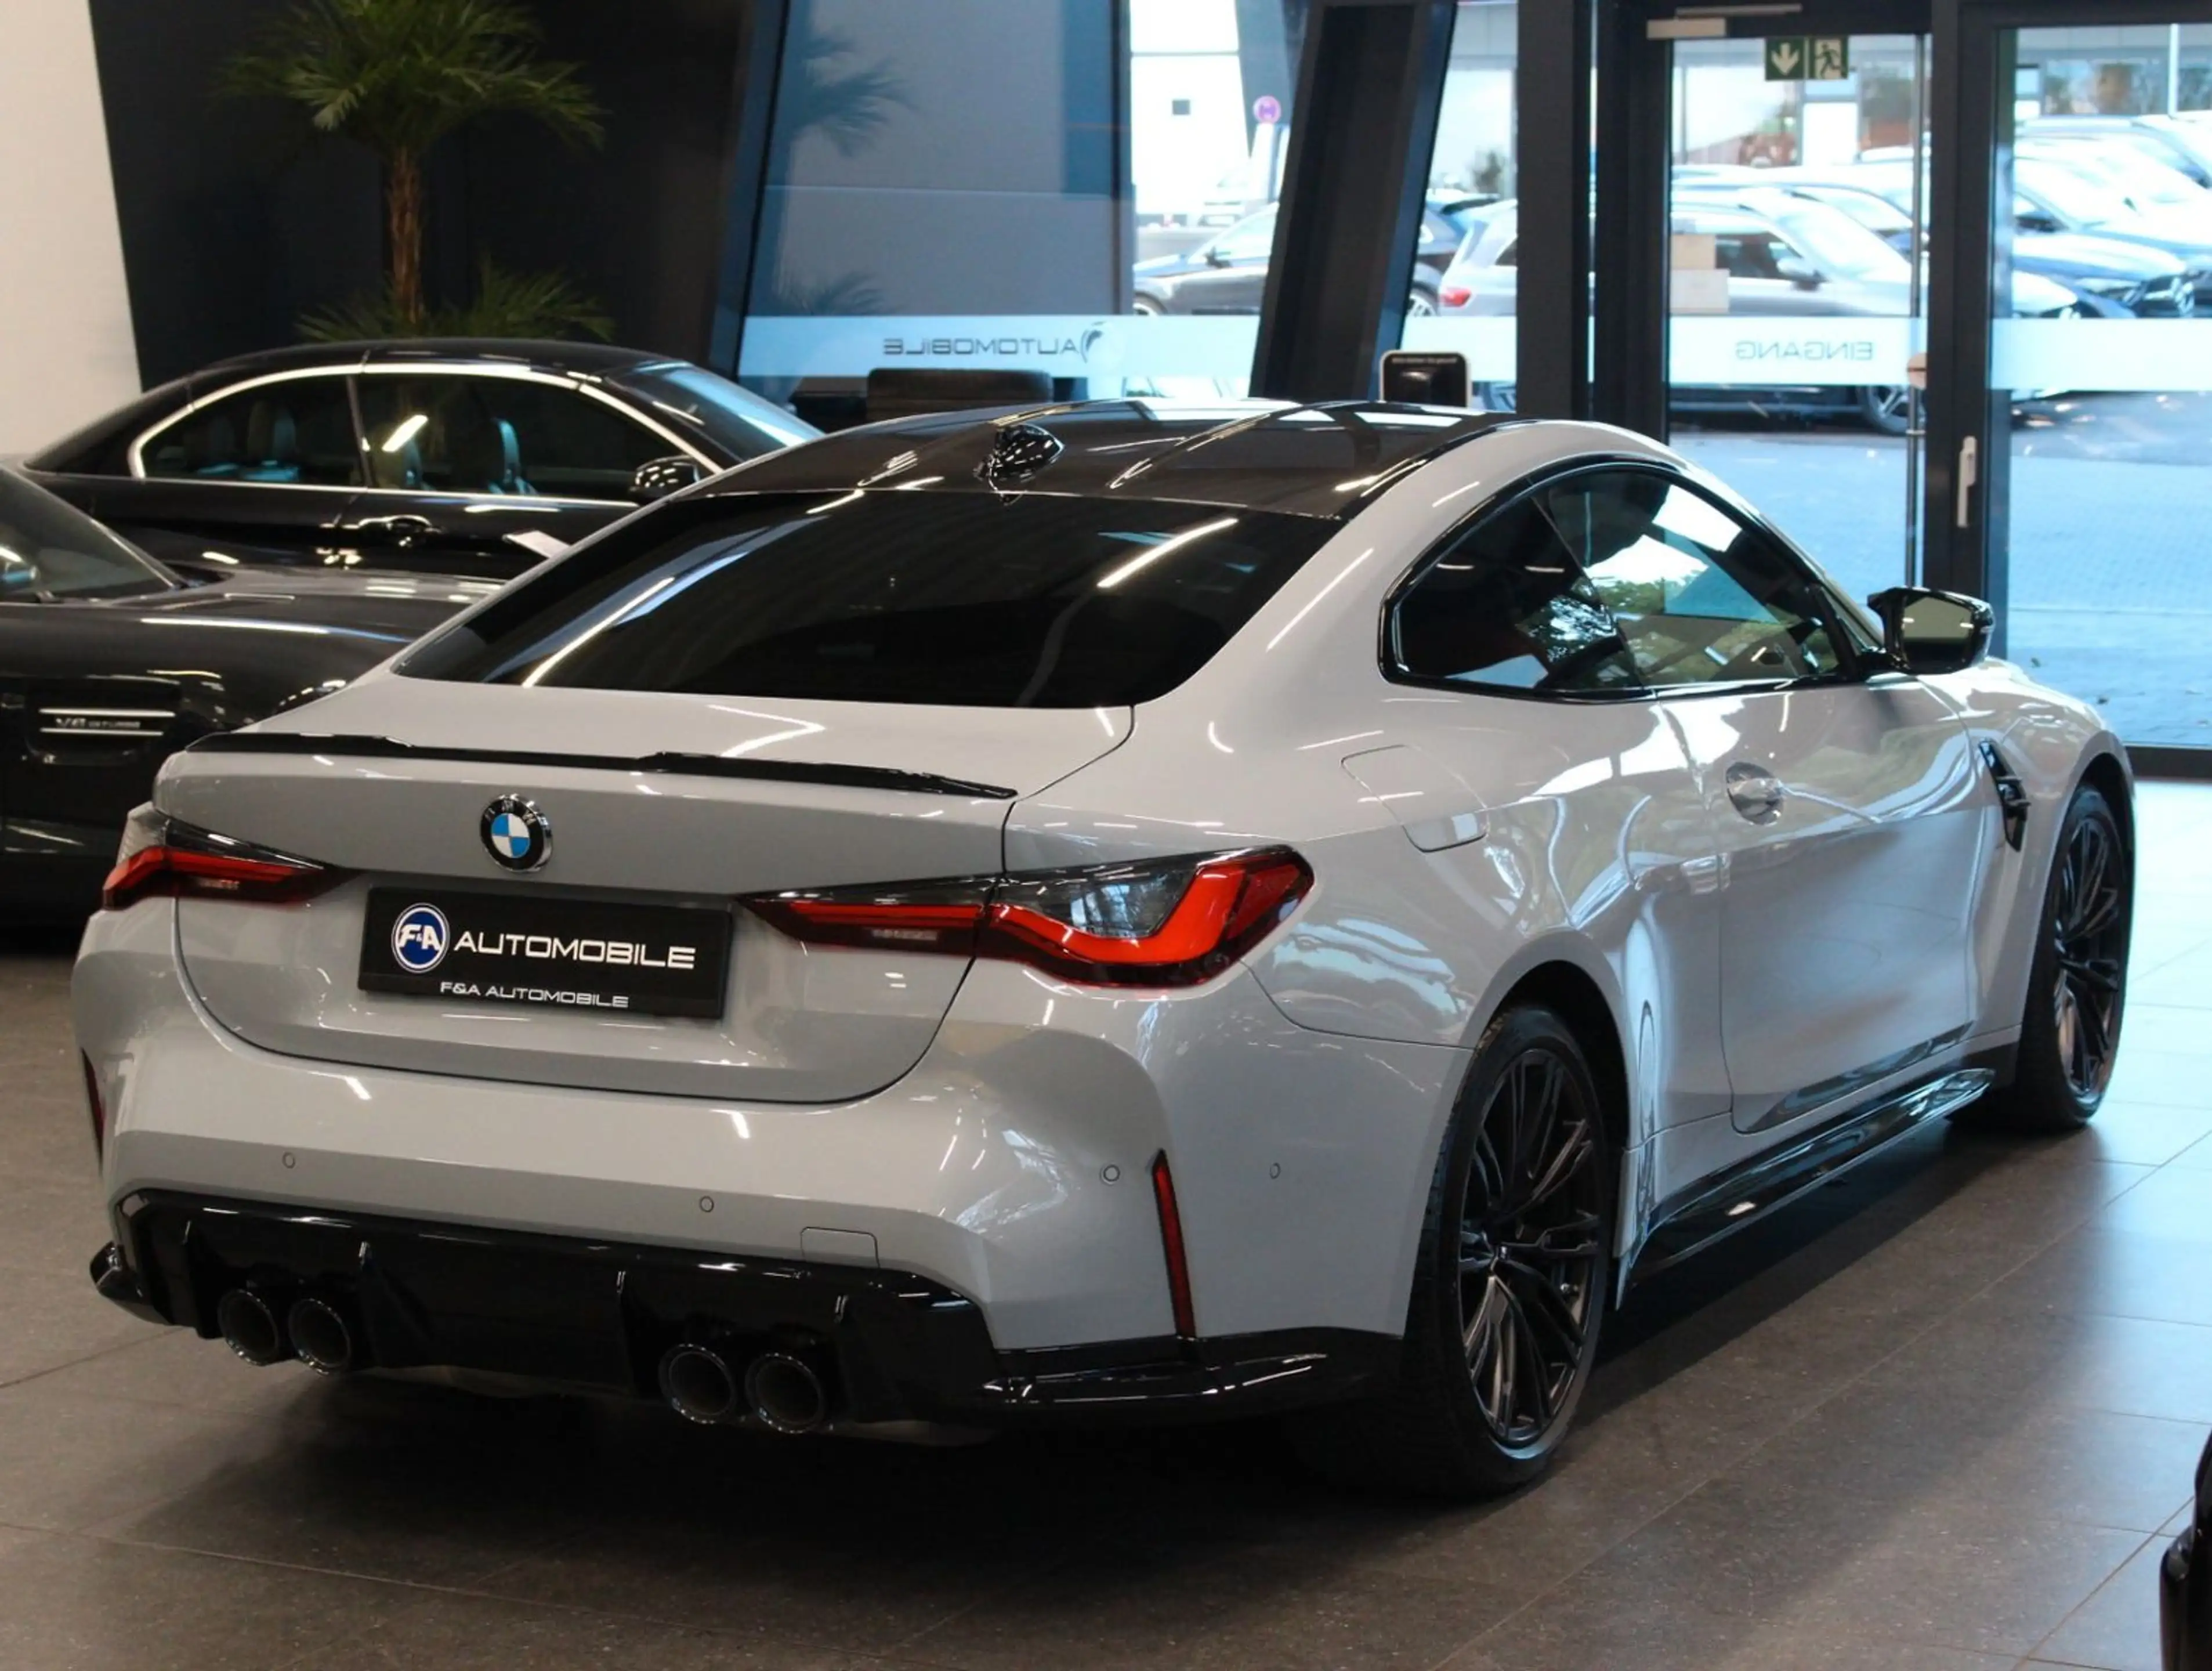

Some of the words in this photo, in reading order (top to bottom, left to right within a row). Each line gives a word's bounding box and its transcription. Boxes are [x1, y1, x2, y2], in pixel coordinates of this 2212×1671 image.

[399, 923, 441, 951] F&A
[454, 931, 696, 970] AUTOMOBILE
[440, 982, 481, 996] F&A
[485, 986, 629, 1008] AUTOMOBILE
